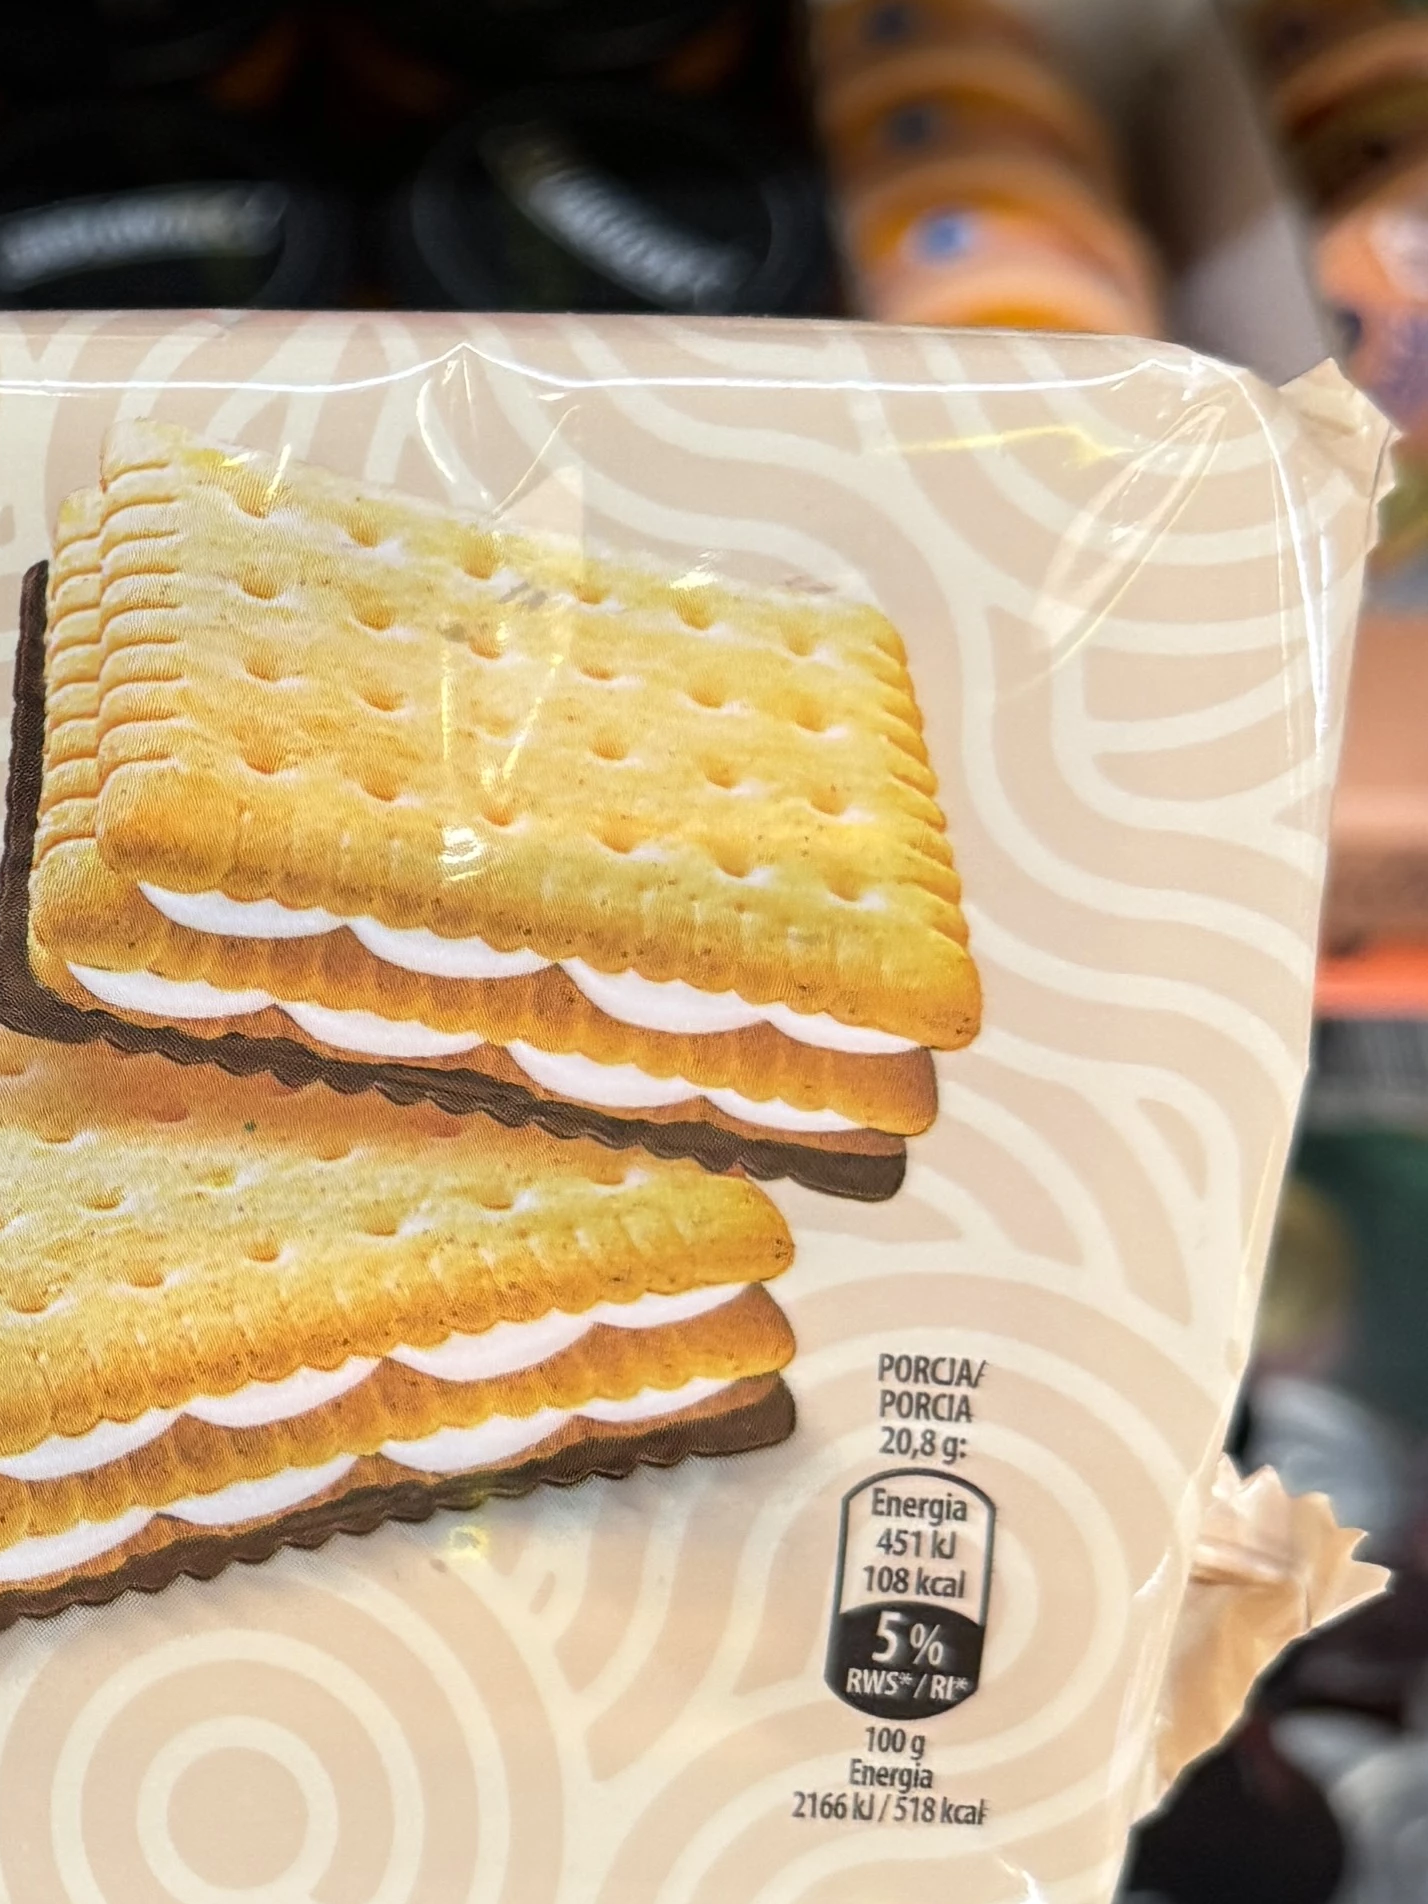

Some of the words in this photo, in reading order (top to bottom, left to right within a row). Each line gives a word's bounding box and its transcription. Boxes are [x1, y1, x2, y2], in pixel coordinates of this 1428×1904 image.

[878, 1353, 988, 1388] PORCJA/
[880, 1390, 971, 1422] PORCIA
[879, 1427, 936, 1460] 20,8
[942, 1438, 968, 1464] g:
[872, 1488, 968, 1525] Energia
[876, 1530, 923, 1558] 451
[931, 1531, 956, 1559] kJ
[863, 1565, 908, 1594] 108
[916, 1567, 964, 1598] kcal
[872, 1610, 900, 1663] 5
[910, 1624, 944, 1665] %
[865, 1727, 906, 1753] 100
[912, 1734, 926, 1760] g
[849, 1758, 933, 1790] Energia
[792, 1792, 847, 1821] 2166
[893, 1796, 936, 1824] 518
[940, 1796, 988, 1826] kcal
